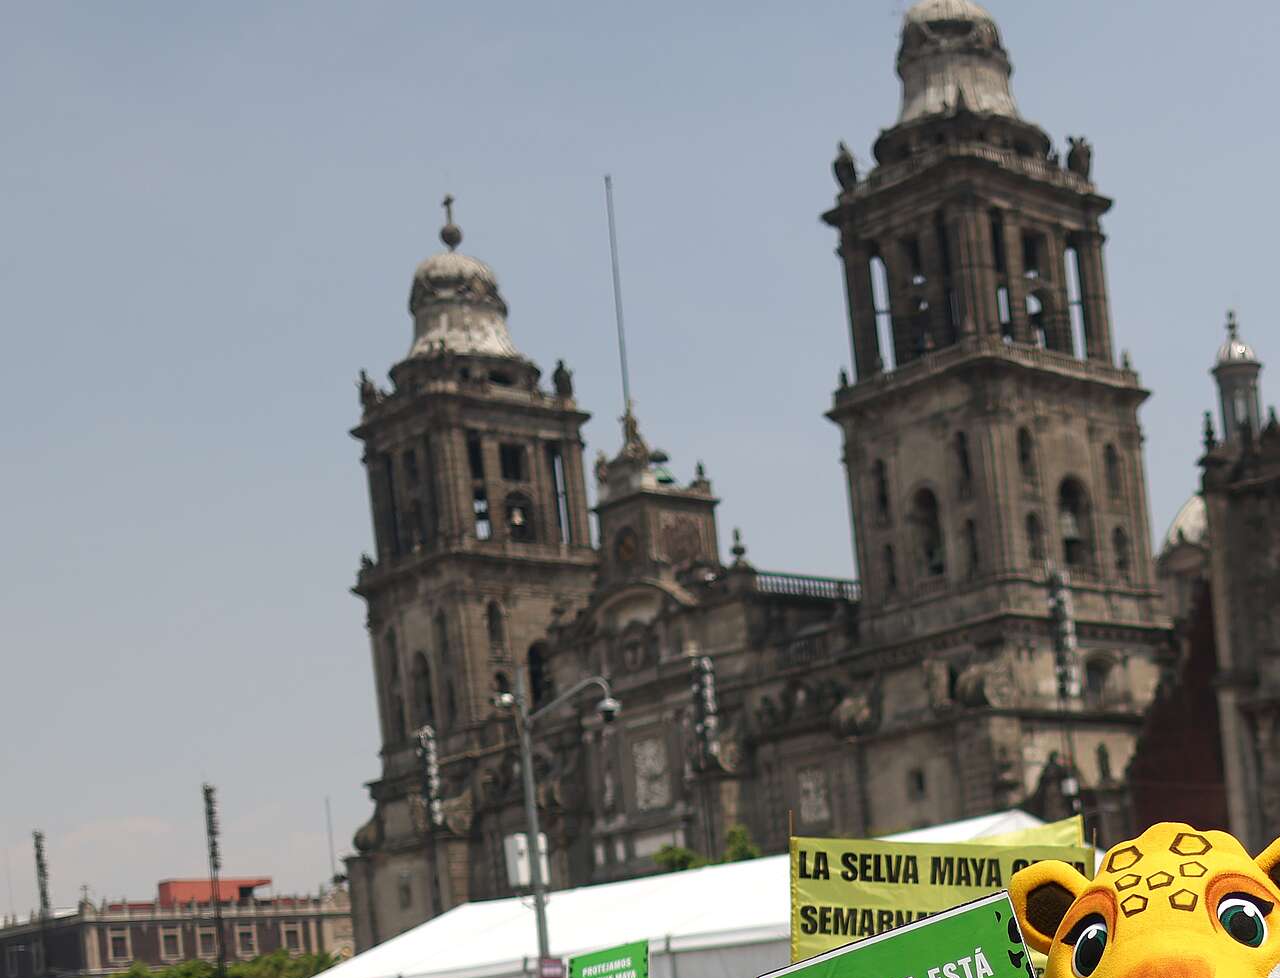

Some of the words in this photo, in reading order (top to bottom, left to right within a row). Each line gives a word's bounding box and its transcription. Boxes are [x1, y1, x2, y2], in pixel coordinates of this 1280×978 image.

[799, 851, 830, 880] LA
[841, 852, 919, 884] SELVA
[930, 856, 1002, 887] MAYA
[800, 905, 938, 937] SEMARN
[582, 957, 632, 978] PROTEJAMOS
